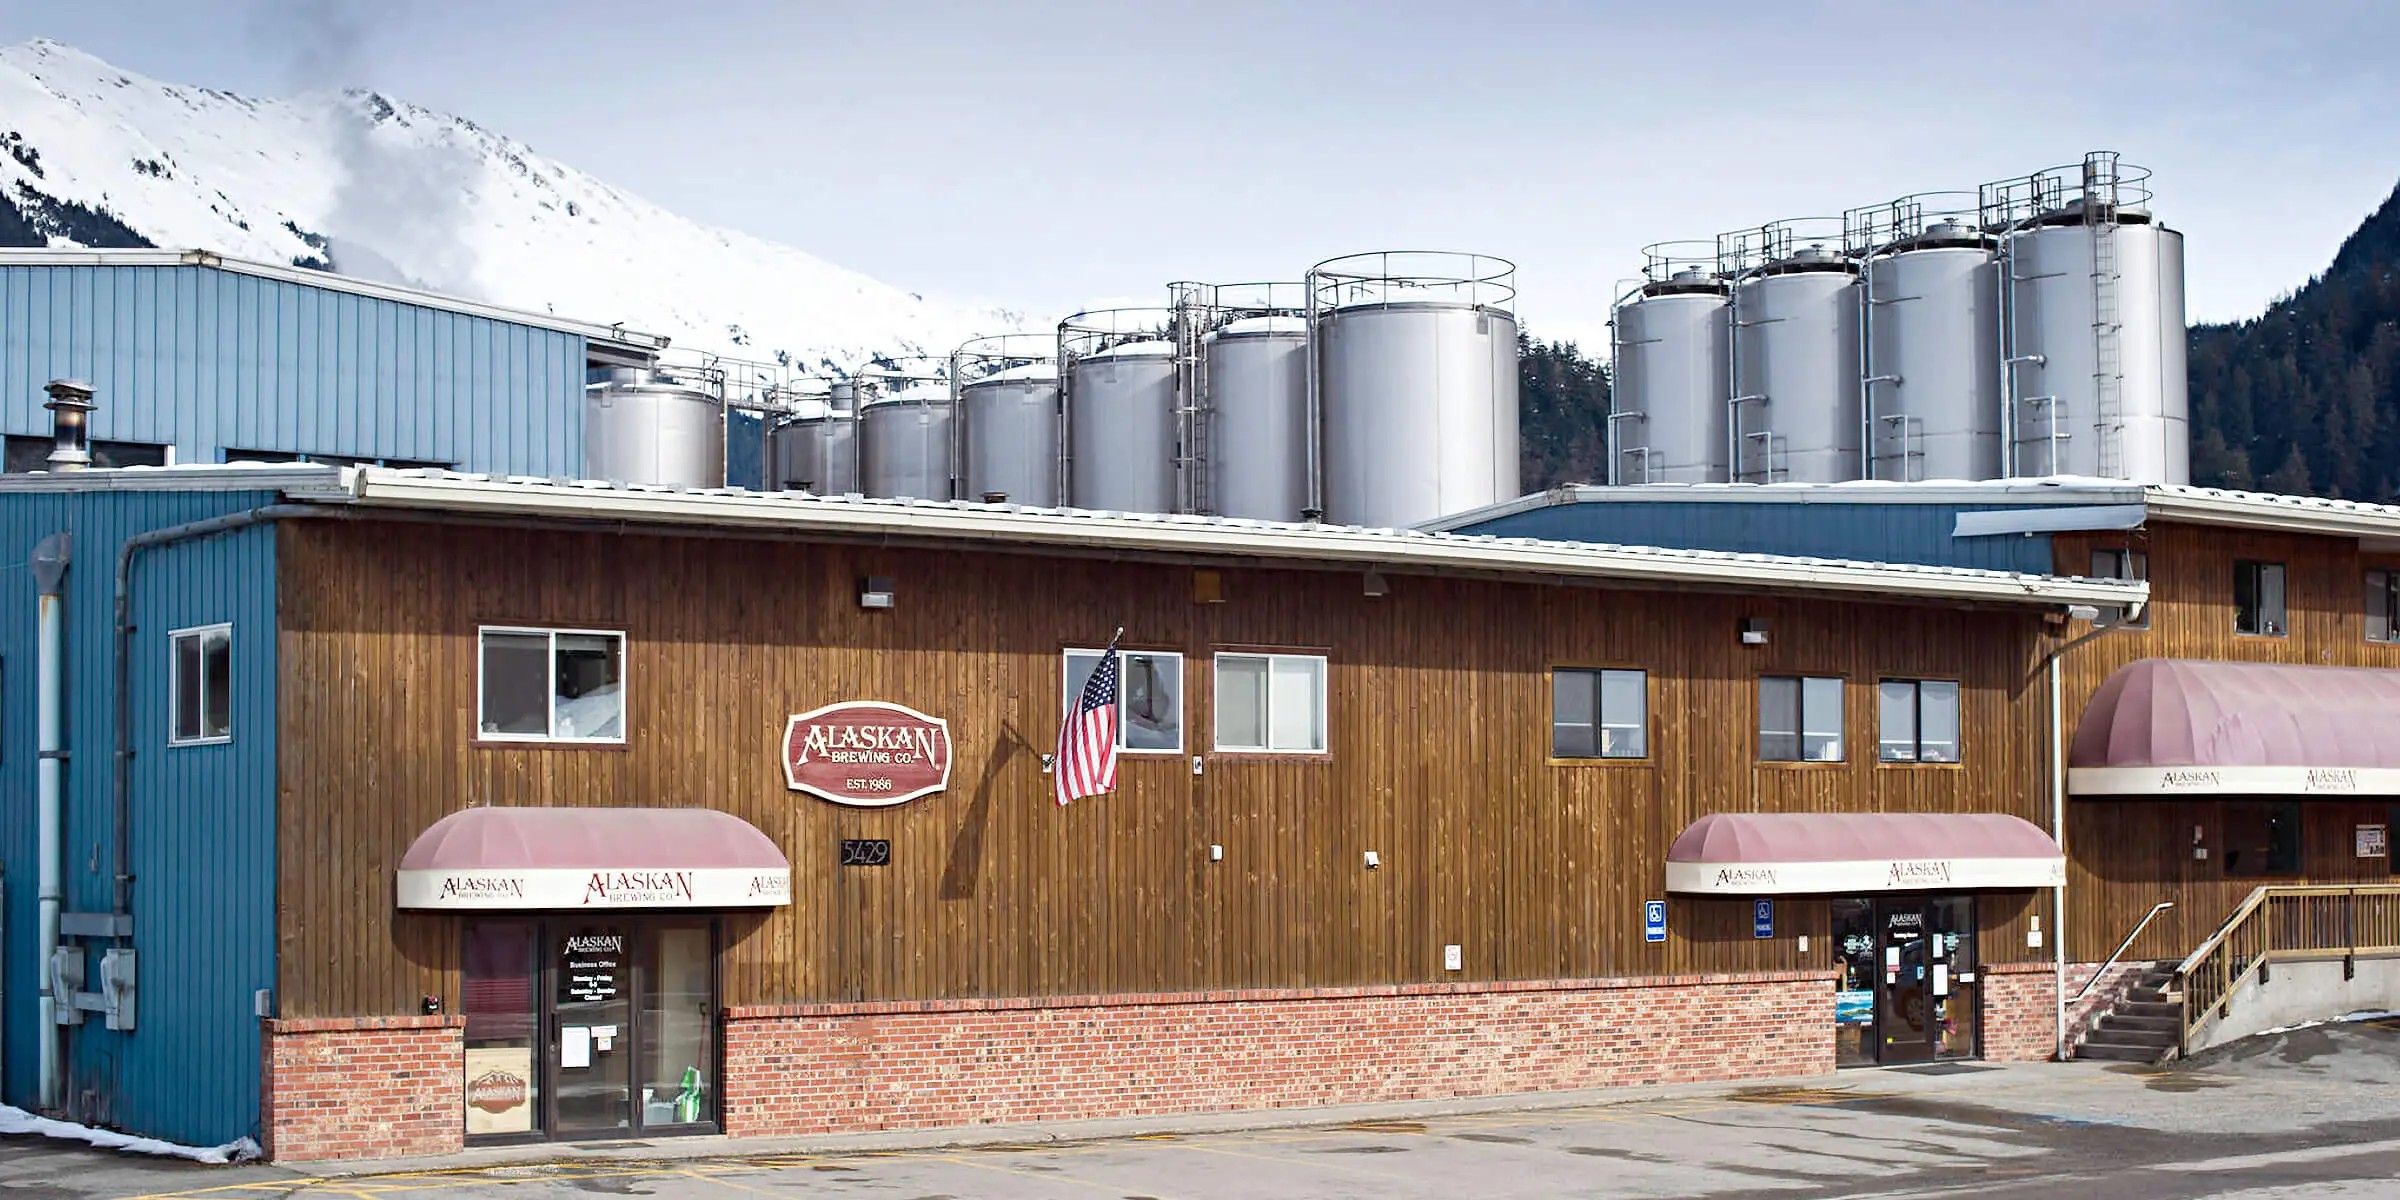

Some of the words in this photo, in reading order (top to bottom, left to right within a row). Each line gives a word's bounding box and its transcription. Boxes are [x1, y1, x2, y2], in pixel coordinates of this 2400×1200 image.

[796, 725, 940, 769] ALASKAN
[831, 750, 890, 764] BREWING
[894, 752, 914, 764] CO.
[846, 779, 868, 789] EST.
[869, 777, 892, 791] 1986
[2162, 771, 2219, 788] ALASKAN
[2305, 769, 2357, 792] ALASKAN
[843, 841, 888, 864] 5429
[1715, 869, 1777, 886] ALASKAN
[1887, 862, 1950, 885] ALASKAN
[440, 878, 524, 900] ALASKAN
[584, 871, 693, 904] ALASKAN
[609, 892, 655, 903] BREWING
[1888, 913, 1922, 928] ALASKAN
[563, 936, 623, 954] ALASKAN
